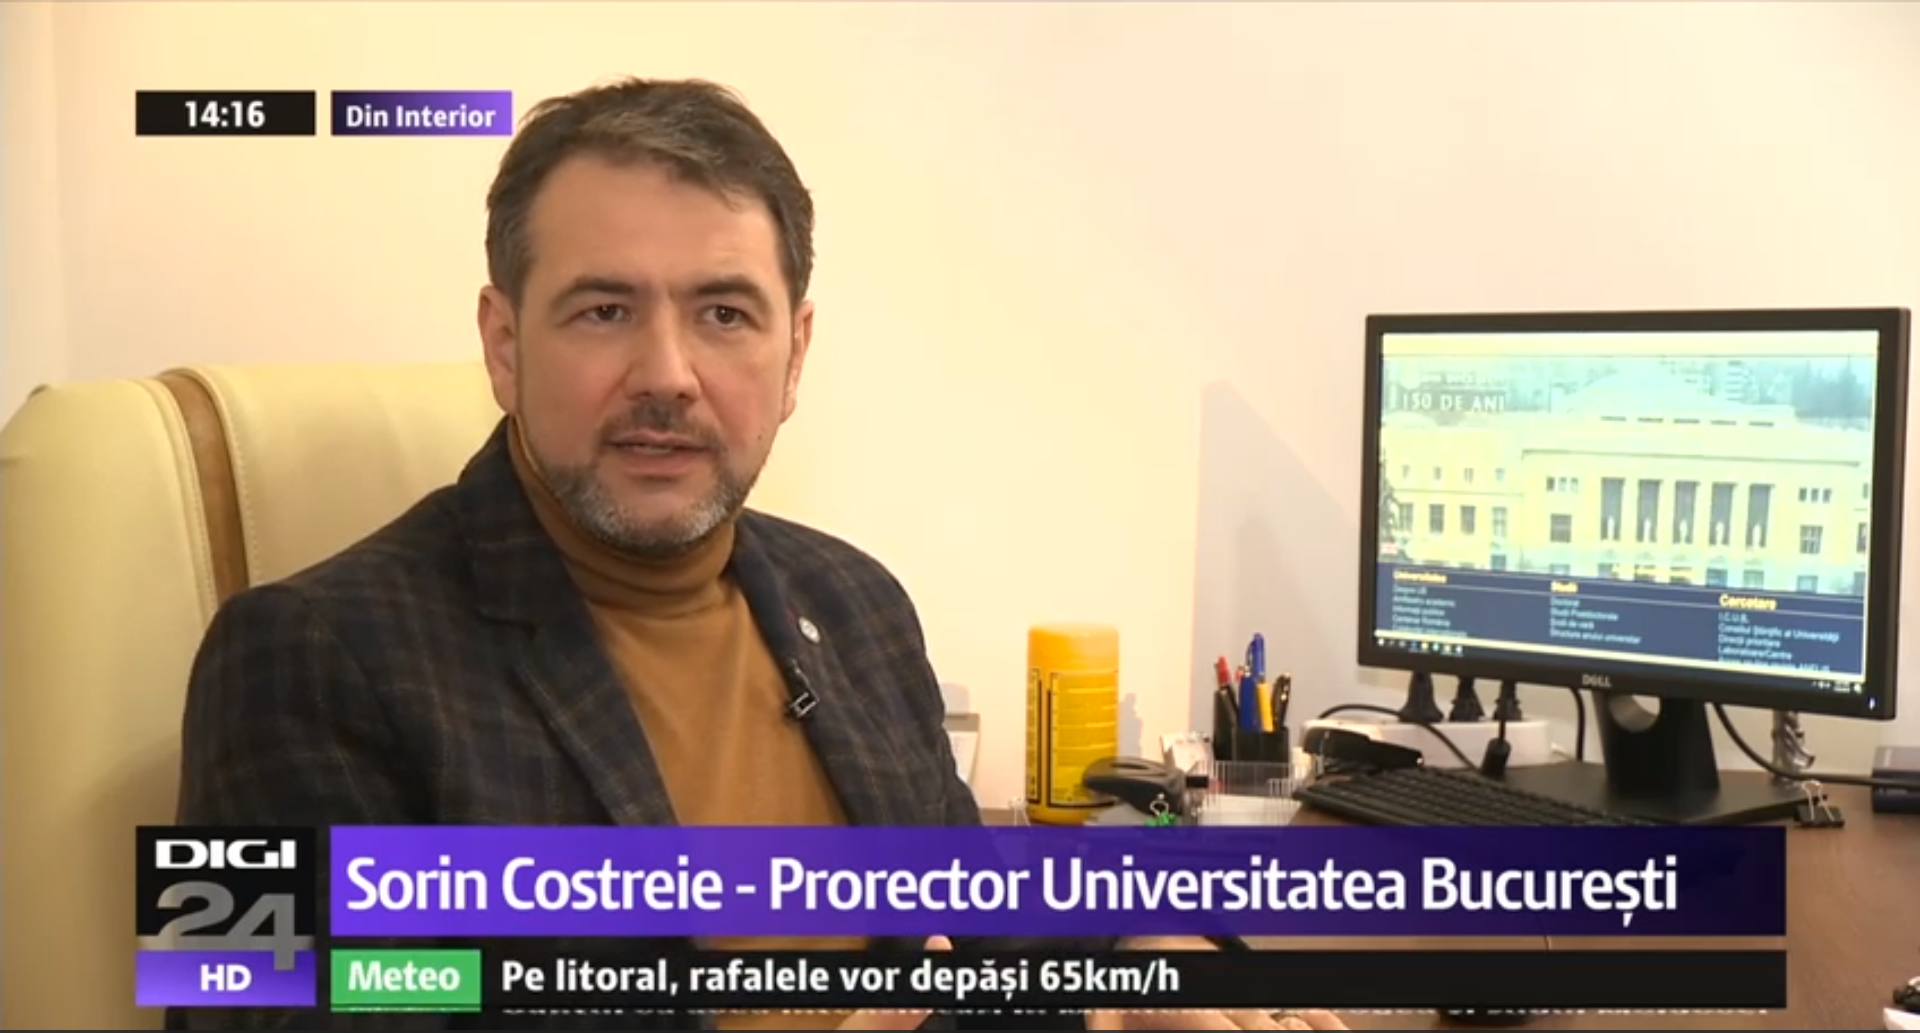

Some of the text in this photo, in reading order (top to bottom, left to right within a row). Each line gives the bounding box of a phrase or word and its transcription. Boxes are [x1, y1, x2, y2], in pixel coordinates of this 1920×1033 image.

[1403, 392, 1506, 413] 150 DE ANI
[1719, 594, 1778, 611] Cercetare
[1581, 673, 1612, 689] DELL
